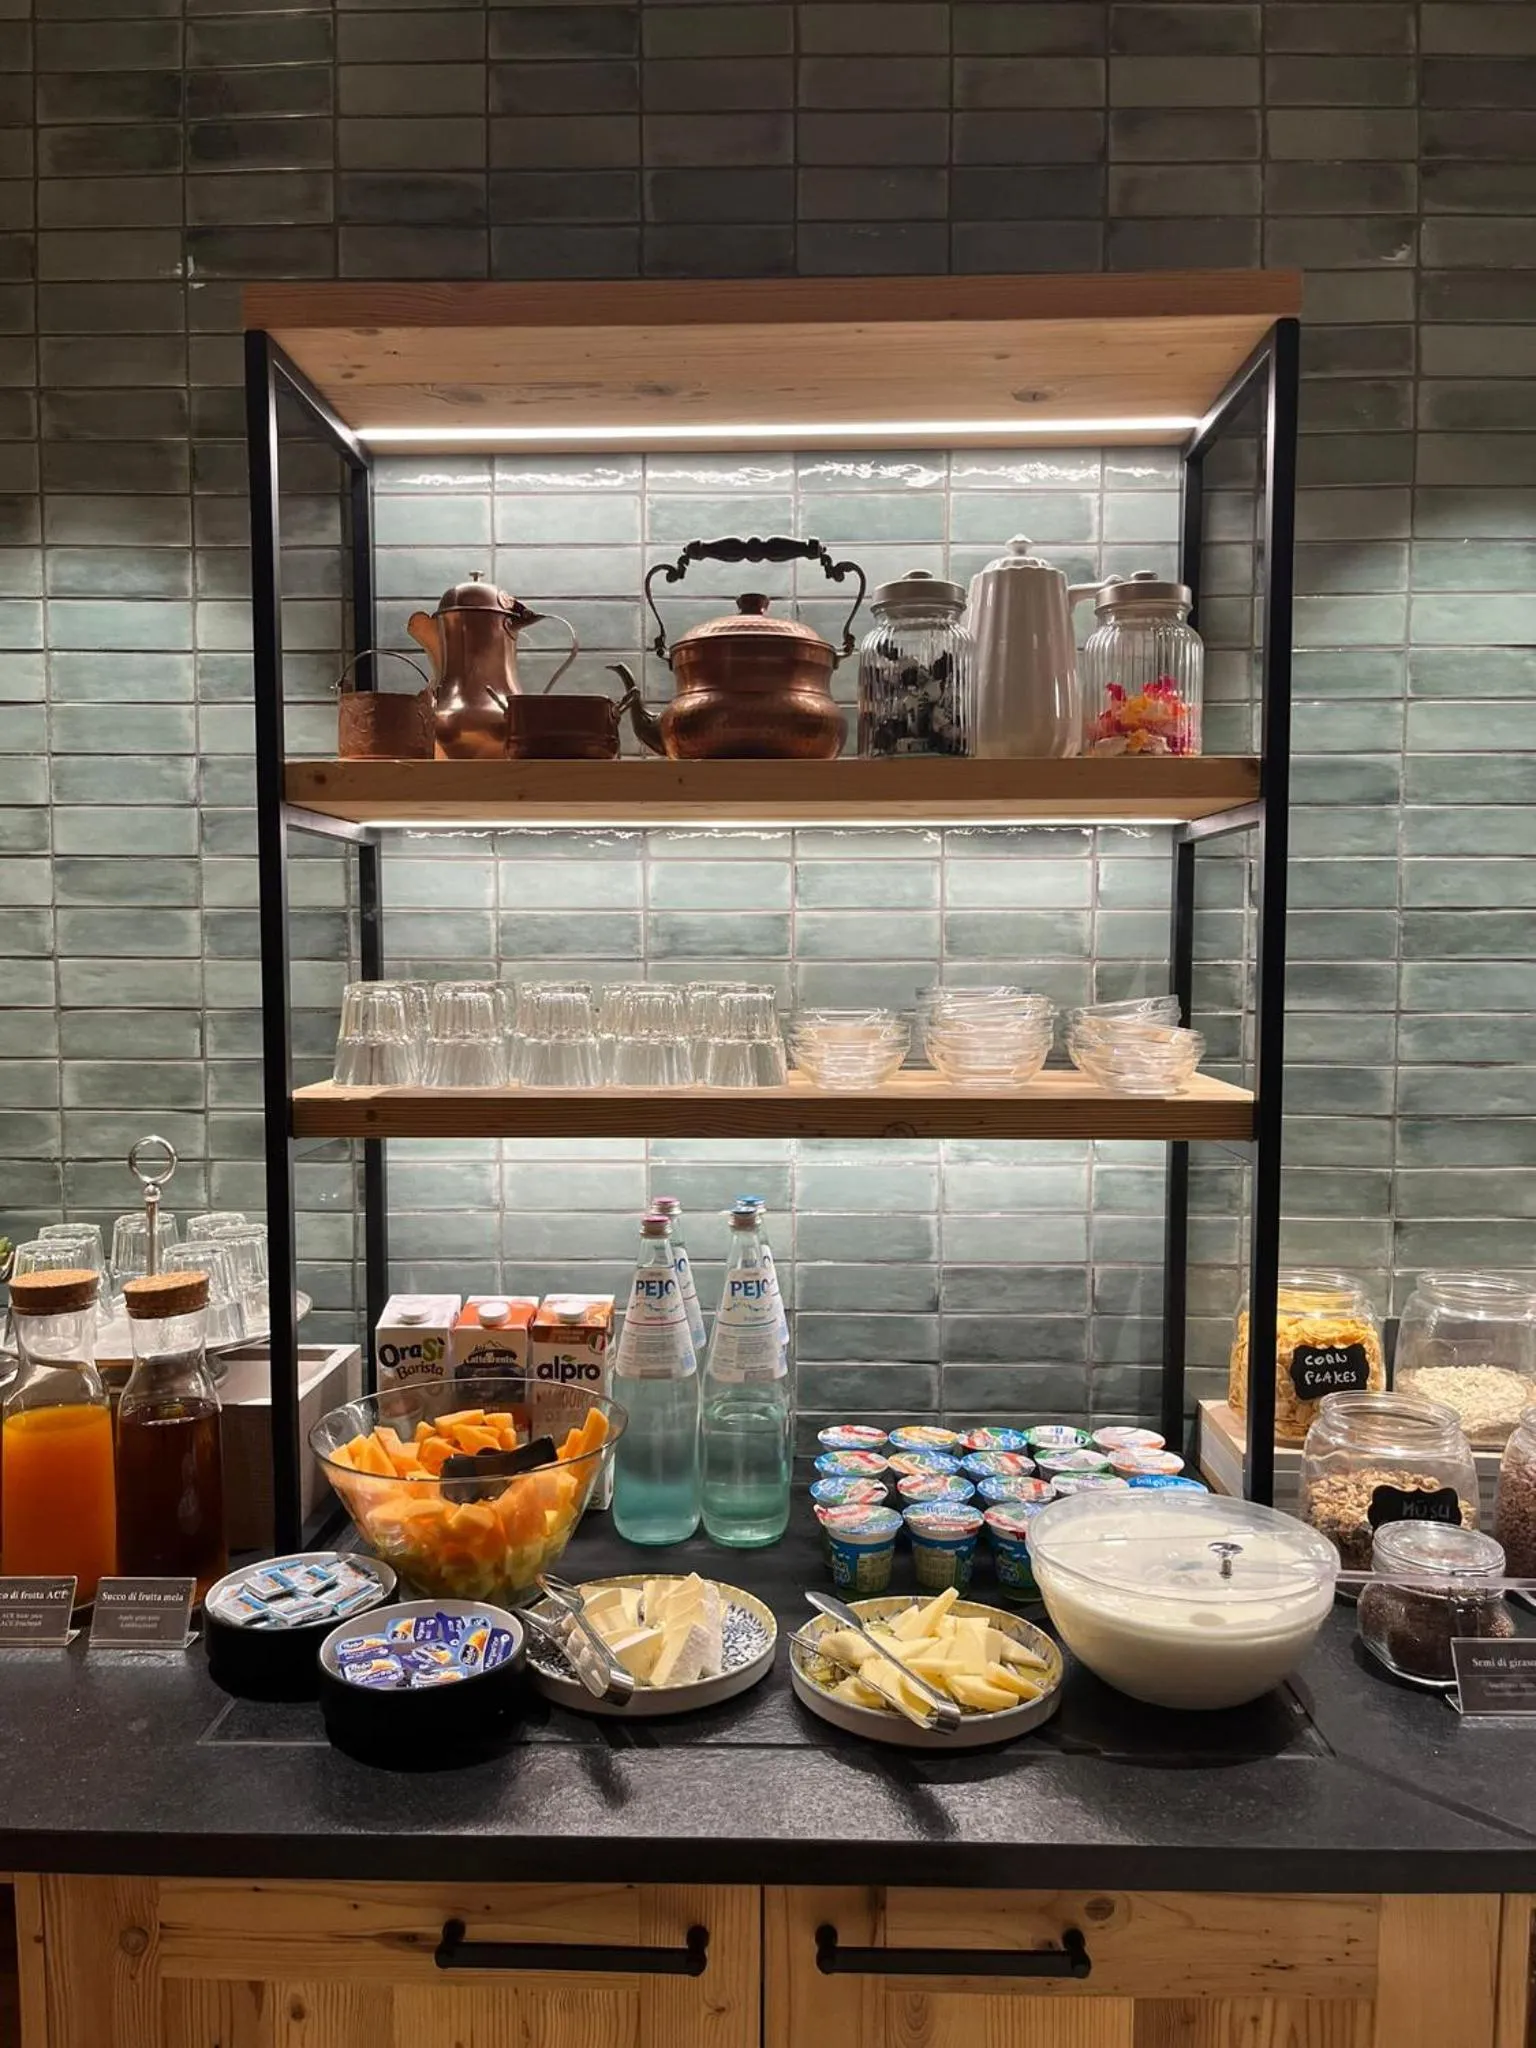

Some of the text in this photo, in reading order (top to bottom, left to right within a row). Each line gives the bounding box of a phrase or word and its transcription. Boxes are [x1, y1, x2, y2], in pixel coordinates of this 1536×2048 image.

[635, 1279, 677, 1299] PEJO
[730, 1279, 771, 1299] PEJO
[1304, 1353, 1348, 1366] CORN
[396, 1359, 445, 1380] Barista
[537, 1355, 601, 1384] alpro
[1304, 1371, 1357, 1385] FLAKES
[10, 1590, 19, 1600] di
[20, 1590, 45, 1600] frutta
[102, 1591, 184, 1602] Succo di frutta mela
[1471, 1658, 1496, 1667] Semi
[1497, 1658, 1507, 1667] di
